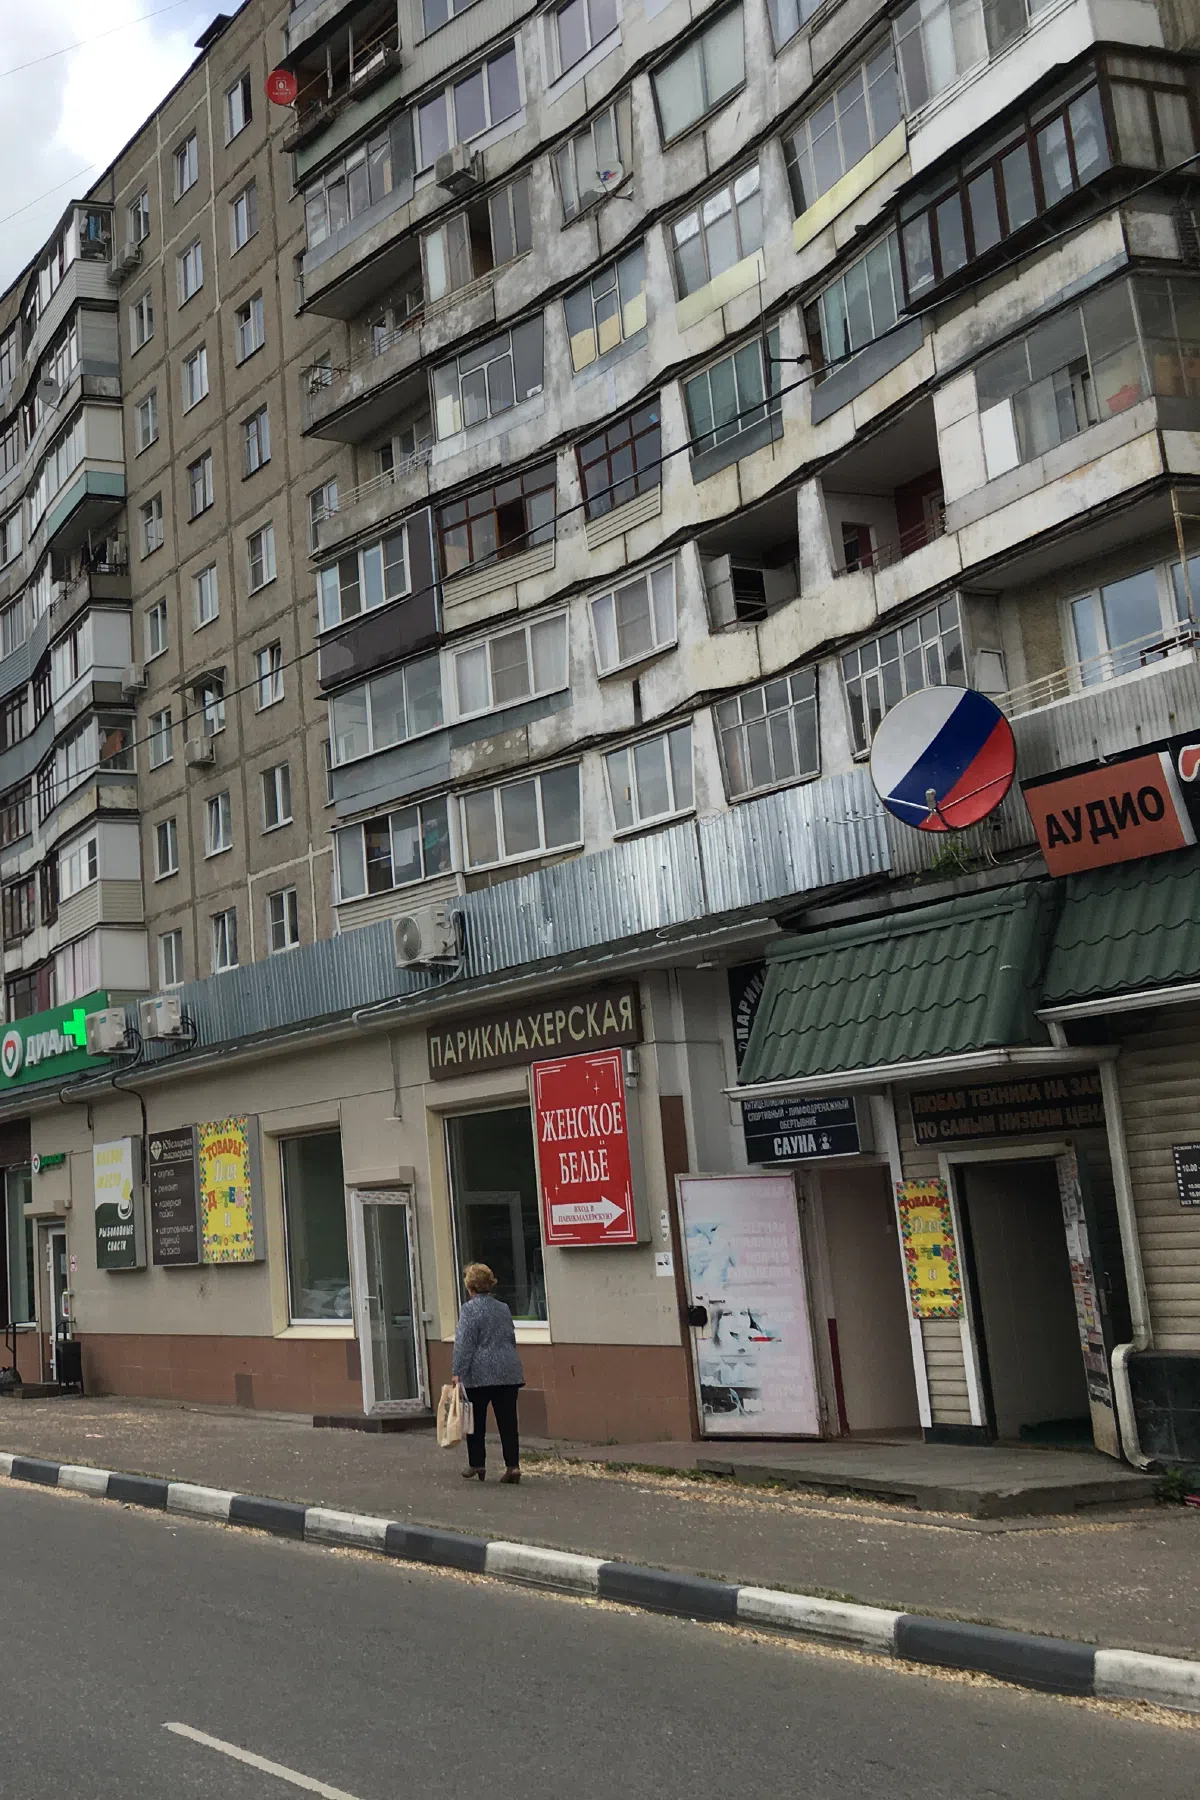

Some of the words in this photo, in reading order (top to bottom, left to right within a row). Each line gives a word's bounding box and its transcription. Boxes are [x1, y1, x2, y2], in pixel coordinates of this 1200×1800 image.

[1045, 786, 1165, 849] АУДИО
[430, 996, 634, 1067] ПАРИКМАХЕРСКАЯ
[25, 1029, 79, 1067] ДИАЛ
[914, 1091, 967, 1114] ЛЮБАЯ
[969, 1083, 1042, 1108] ТЕХНИКА
[1044, 1079, 1068, 1099] НА
[1070, 1075, 1102, 1096] ЗАК
[747, 1107, 785, 1122] СПОРТИВНЫЙ
[788, 1098, 850, 1116] ЛИМФОДРЕНАЖНЫЙ
[540, 1102, 624, 1143] ЖЕНСКОЕ
[918, 1121, 938, 1139] ПО
[940, 1114, 996, 1137] САМЫМ
[999, 1107, 1063, 1131] НИЗКИМ
[205, 1138, 242, 1161] ТОВАРЫ
[773, 1133, 818, 1156] САУНА
[558, 1139, 611, 1185] БЕЛЬЁ
[158, 1183, 179, 1194] ремонт
[558, 1212, 613, 1223] ПАРИКМАХЕРСКУЮ
[573, 1204, 590, 1213] ВХОД
[99, 1224, 135, 1238] РЫБОЛОВНЫЕ
[107, 1240, 127, 1252] СНАСТИ
